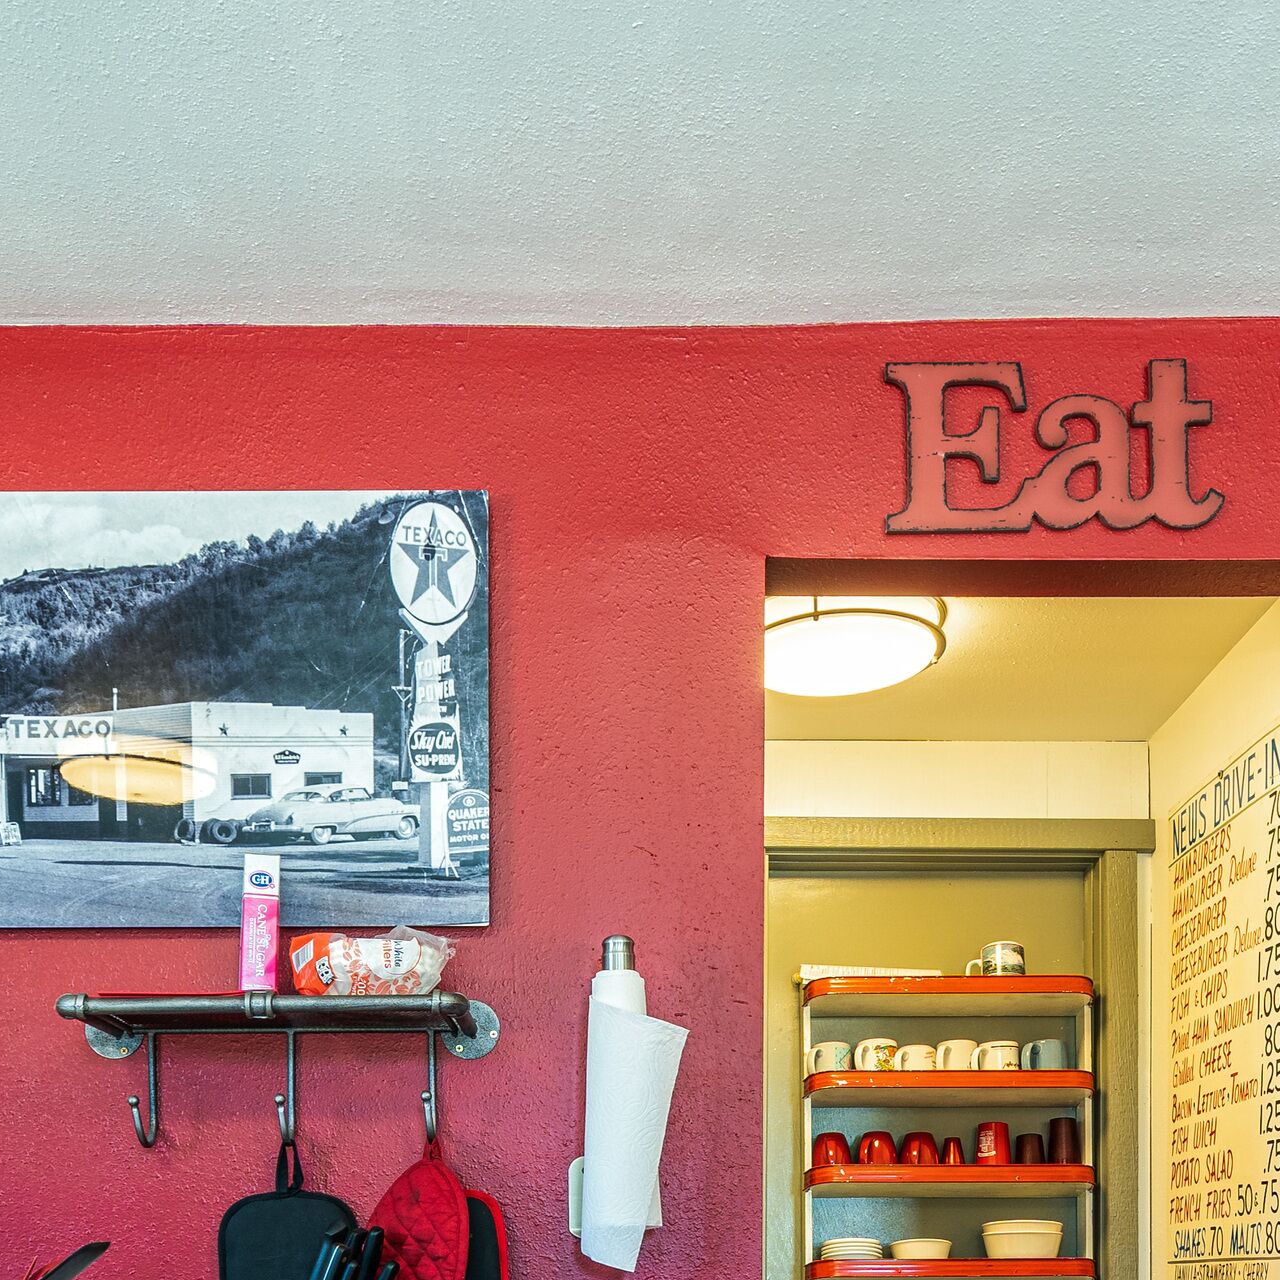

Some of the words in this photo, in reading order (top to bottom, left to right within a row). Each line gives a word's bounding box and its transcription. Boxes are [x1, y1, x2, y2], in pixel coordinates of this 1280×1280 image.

[885, 359, 1225, 534] Eat
[403, 525, 467, 546] TEXACO
[416, 655, 452, 678] TOWER
[418, 679, 455, 704] POWER
[9, 719, 111, 739] TEXACO
[411, 731, 434, 753] Sky
[450, 834, 478, 842] MOTOR
[453, 819, 489, 832] STATE
[1172, 794, 1207, 859] NEWS
[1174, 824, 1231, 890] HAMBURGERS
[1172, 863, 1223, 924] HAMBURGER
[1228, 846, 1257, 888] Deluxe
[257, 904, 268, 935] CANE
[1171, 896, 1227, 956] CHEESEBURGER
[255, 940, 266, 977] SUGAR
[1170, 932, 1228, 990] CHEESEBURGER
[1233, 917, 1261, 958] Deluxe
[1171, 987, 1190, 1024] FISH
[1200, 968, 1228, 1008] CHIPS
[1171, 1023, 1190, 1059] Fried
[1192, 1014, 1209, 1045] HAM
[1214, 994, 1255, 1038] SANDWICH
[1172, 1054, 1195, 1088] Grilled
[1199, 1040, 1232, 1078] CHEESE
[1171, 1125, 1189, 1157] FISH
[1193, 1117, 1218, 1149] WICH
[1170, 1158, 1201, 1191] POTATO
[1205, 1149, 1233, 1184] SALAD
[1169, 1193, 1201, 1225] FRENCH
[1206, 1188, 1232, 1220] FRIES
[1234, 1184, 1253, 1217] .50
[1259, 1178, 1280, 1214] .75
[1174, 1227, 1206, 1258] SHAKES
[1208, 1226, 1224, 1256] .70
[1230, 1222, 1262, 1256] MALTS
